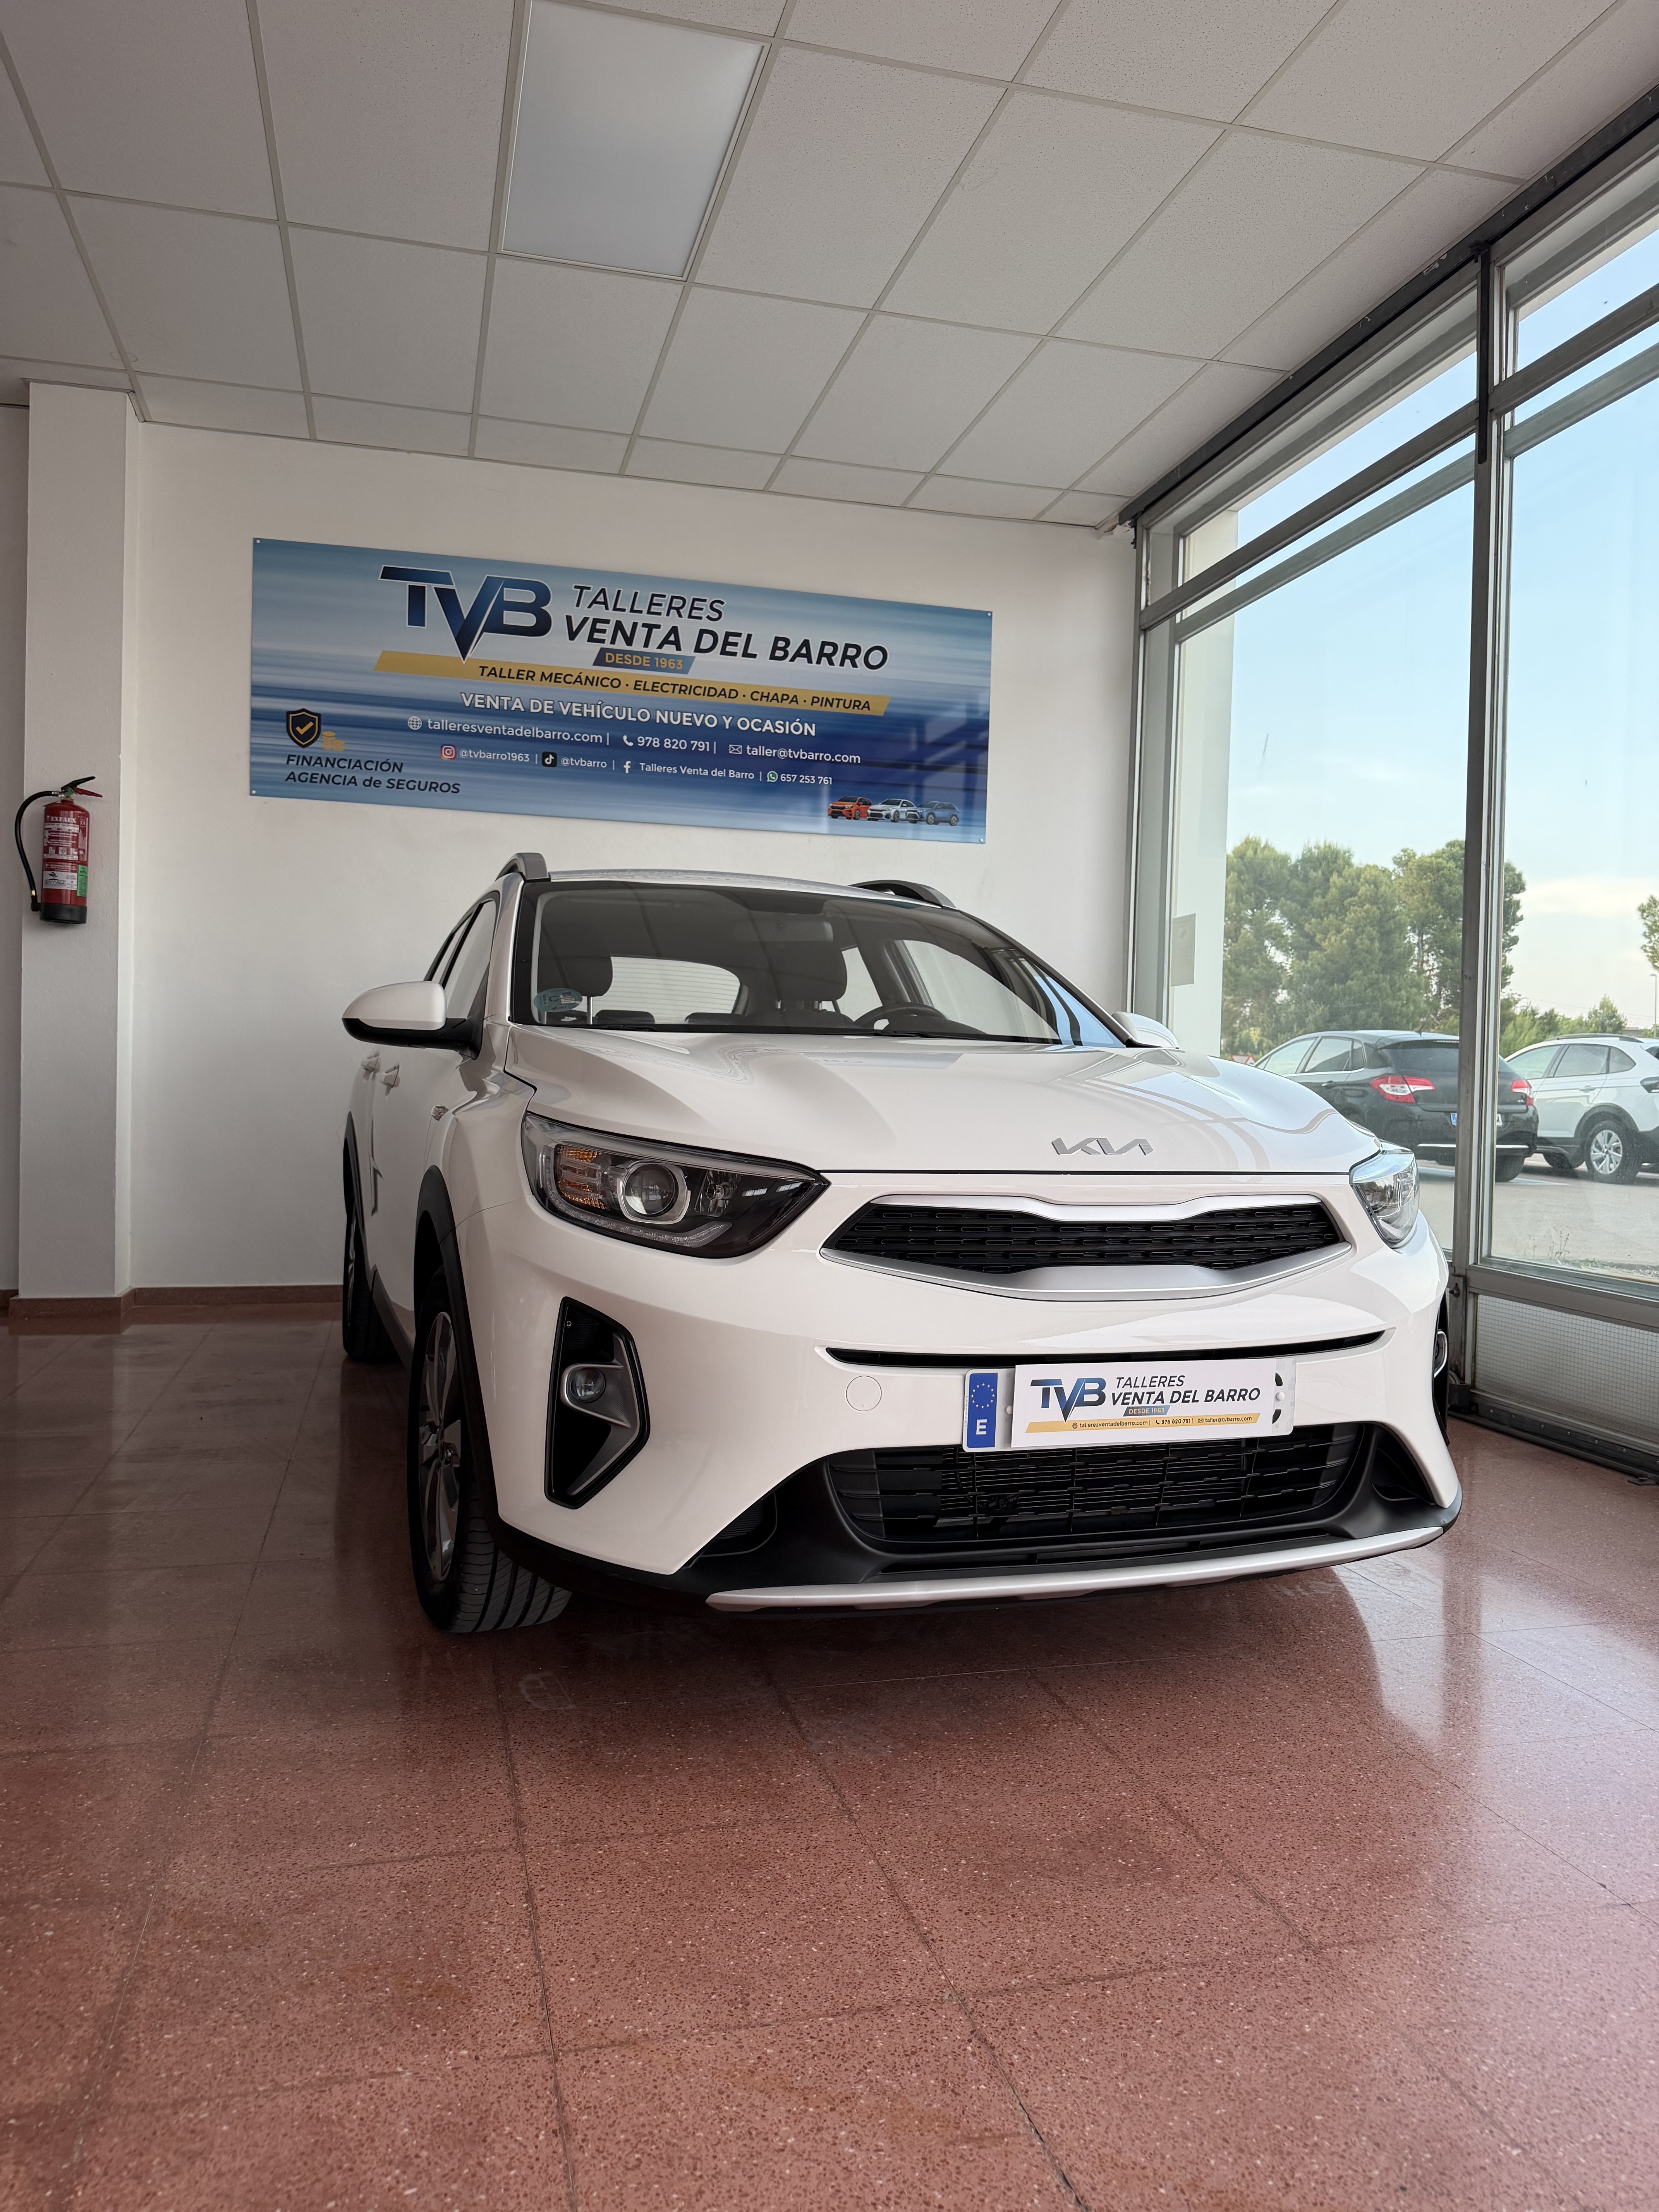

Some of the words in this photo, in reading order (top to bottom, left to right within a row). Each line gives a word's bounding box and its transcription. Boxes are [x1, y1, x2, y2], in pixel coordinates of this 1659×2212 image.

[572, 584, 725, 622] TALLERES
[379, 565, 552, 665] TVB
[565, 615, 682, 652] VENTA
[693, 628, 758, 659] DEL
[769, 636, 888, 670] BARRO
[605, 653, 650, 667] DESDE
[654, 657, 683, 670] 1963
[479, 665, 536, 681] TALLER
[541, 672, 621, 689] MECÁNICO
[633, 680, 739, 699] ELECTRICIDAD
[750, 690, 799, 704] CHAPA
[810, 696, 871, 711] PINTURA
[460, 693, 525, 712] VENTA
[530, 699, 555, 714] DE
[559, 700, 651, 723] VEHÍCULO
[656, 710, 717, 728] NUEVO
[722, 716, 733, 729] Y
[737, 718, 816, 736] OCASIÓN
[428, 719, 603, 743] talleresventadelbarro.com
[637, 736, 660, 748] 978
[663, 738, 687, 750] 820
[690, 740, 709, 752] 791
[286, 754, 404, 773] FINANCIACIÓN
[460, 749, 530, 762] @tvbarro1963
[561, 757, 607, 768] @tvbarro
[747, 745, 861, 764] taller@tvbarro.com
[639, 763, 678, 774] Talleres
[679, 766, 709, 776] Venta
[711, 768, 726, 777] del
[728, 770, 754, 780] Barro
[780, 774, 797, 783] 657
[799, 775, 816, 784] 253
[818, 776, 833, 785] 761
[285, 771, 358, 787] AGENCIA
[362, 777, 382, 788] de
[386, 778, 461, 794] SEGUROS
[1116, 1375, 1185, 1389] TALLERES
[1030, 1377, 1106, 1423] TVB
[1112, 1391, 1164, 1405] VENTA
[1169, 1390, 1199, 1404] DEL
[1204, 1388, 1261, 1403] BARRO
[976, 1419, 987, 1435] E
